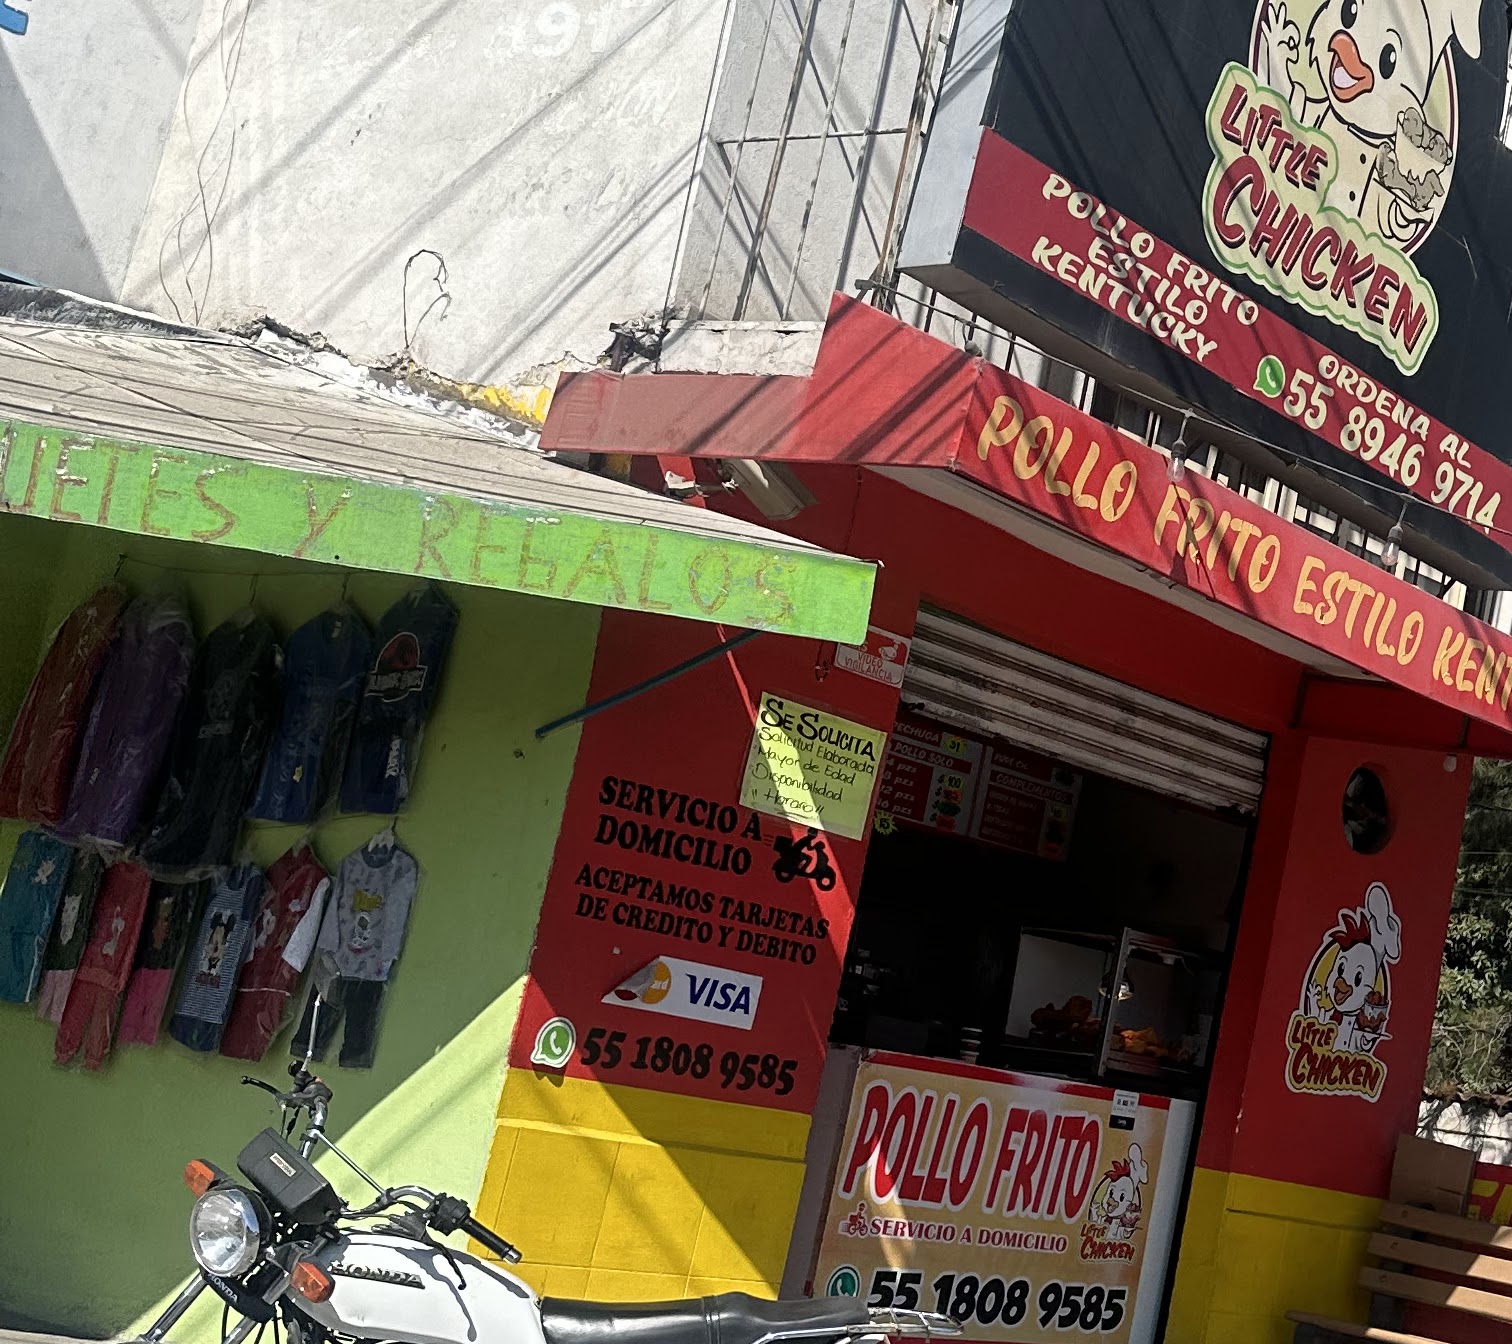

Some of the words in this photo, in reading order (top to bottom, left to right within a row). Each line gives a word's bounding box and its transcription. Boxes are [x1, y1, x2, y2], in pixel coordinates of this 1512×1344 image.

[1220, 84, 1329, 191] LITTLE
[1042, 173, 1155, 258] POLLO
[1167, 252, 1259, 325] FRITO
[1088, 236, 1208, 325] ESTILO
[1213, 154, 1429, 354] CHICKEN
[1031, 236, 1218, 362] KENTUCKY
[1319, 355, 1429, 440] ORDENA
[1439, 432, 1472, 469] AL
[1283, 368, 1336, 429] 55
[1340, 405, 1425, 486] 8946
[1430, 460, 1502, 534] 9714
[294, 479, 352, 558] Y
[977, 395, 1138, 522] POLLO
[1152, 482, 1281, 593] FRITO
[1293, 555, 1424, 665] ESTILO
[844, 656, 893, 682] VIGILANCIA
[858, 652, 883, 668] VIDEO
[796, 713, 876, 762] SOLICITA
[894, 742, 927, 759] POLLO
[803, 758, 821, 773] de
[824, 765, 856, 786] Edad
[598, 775, 739, 834] SERVICIO
[741, 811, 762, 842] A
[594, 814, 752, 876] DOMICILIO
[575, 862, 715, 914] ACEPTAMOS
[719, 896, 830, 941] TARJETAS
[575, 893, 607, 921] DE
[613, 903, 713, 944] CREDITO
[718, 925, 735, 948] Y
[736, 929, 817, 966] DEBITO
[686, 972, 751, 1015] VISA
[581, 1027, 626, 1069] 55
[630, 1036, 713, 1079] 1808
[720, 1051, 799, 1096] 9585
[1291, 1019, 1335, 1048] LITTLE
[1291, 1042, 1381, 1092] CHICKEN
[842, 1083, 990, 1207] POLLO
[985, 1107, 1100, 1220] FRITO
[870, 1218, 956, 1243] SERVICIO
[960, 1228, 973, 1244] A
[977, 1228, 1068, 1253] DOMICILIO
[1080, 1235, 1136, 1262] CHICKEN
[867, 1270, 923, 1318] 55
[932, 1274, 1030, 1326] 1808
[1037, 1282, 1127, 1331] 9585
